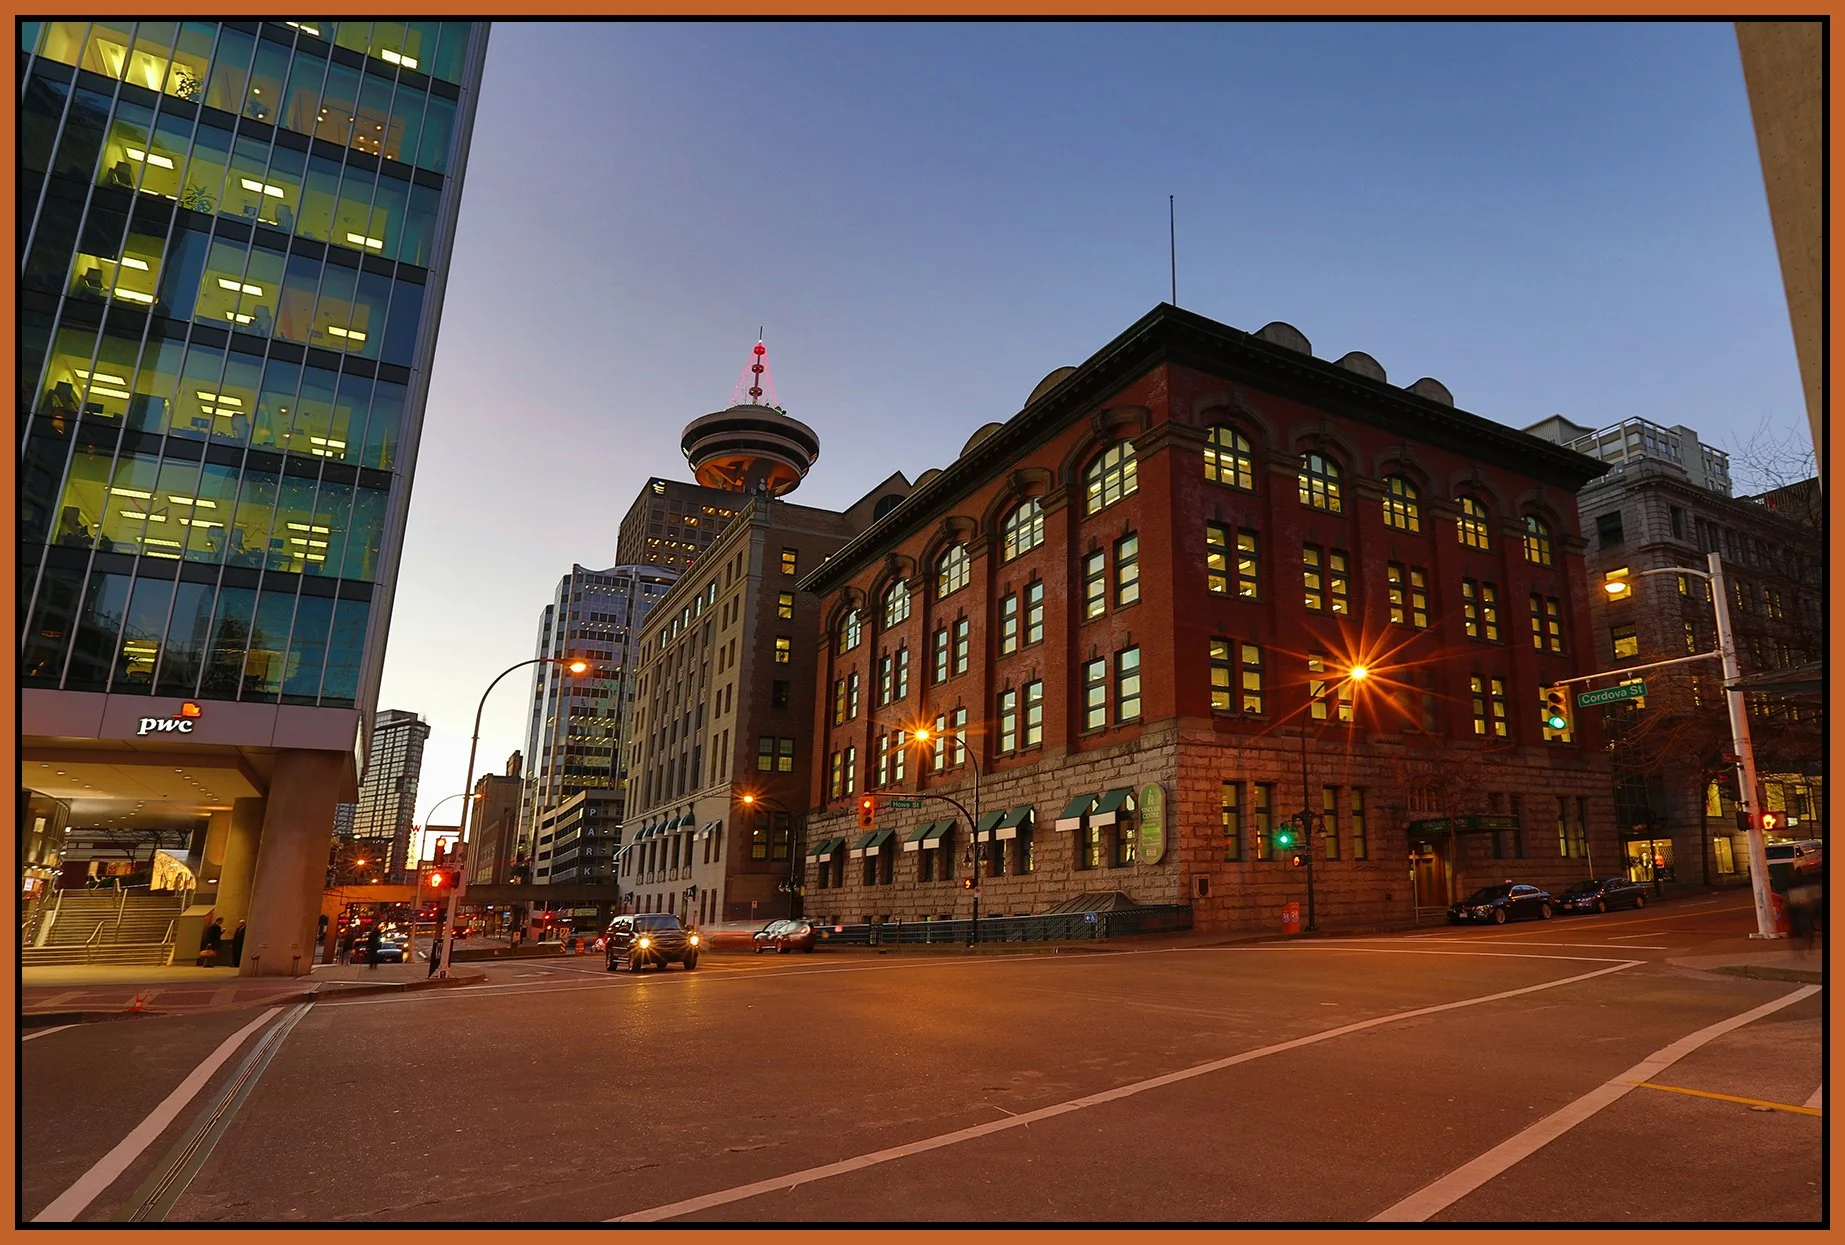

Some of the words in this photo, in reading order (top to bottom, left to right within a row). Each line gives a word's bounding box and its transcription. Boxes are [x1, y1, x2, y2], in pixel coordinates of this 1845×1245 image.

[1581, 689, 1627, 703] Cordova
[1630, 685, 1643, 695] St
[137, 718, 193, 735] pwc
